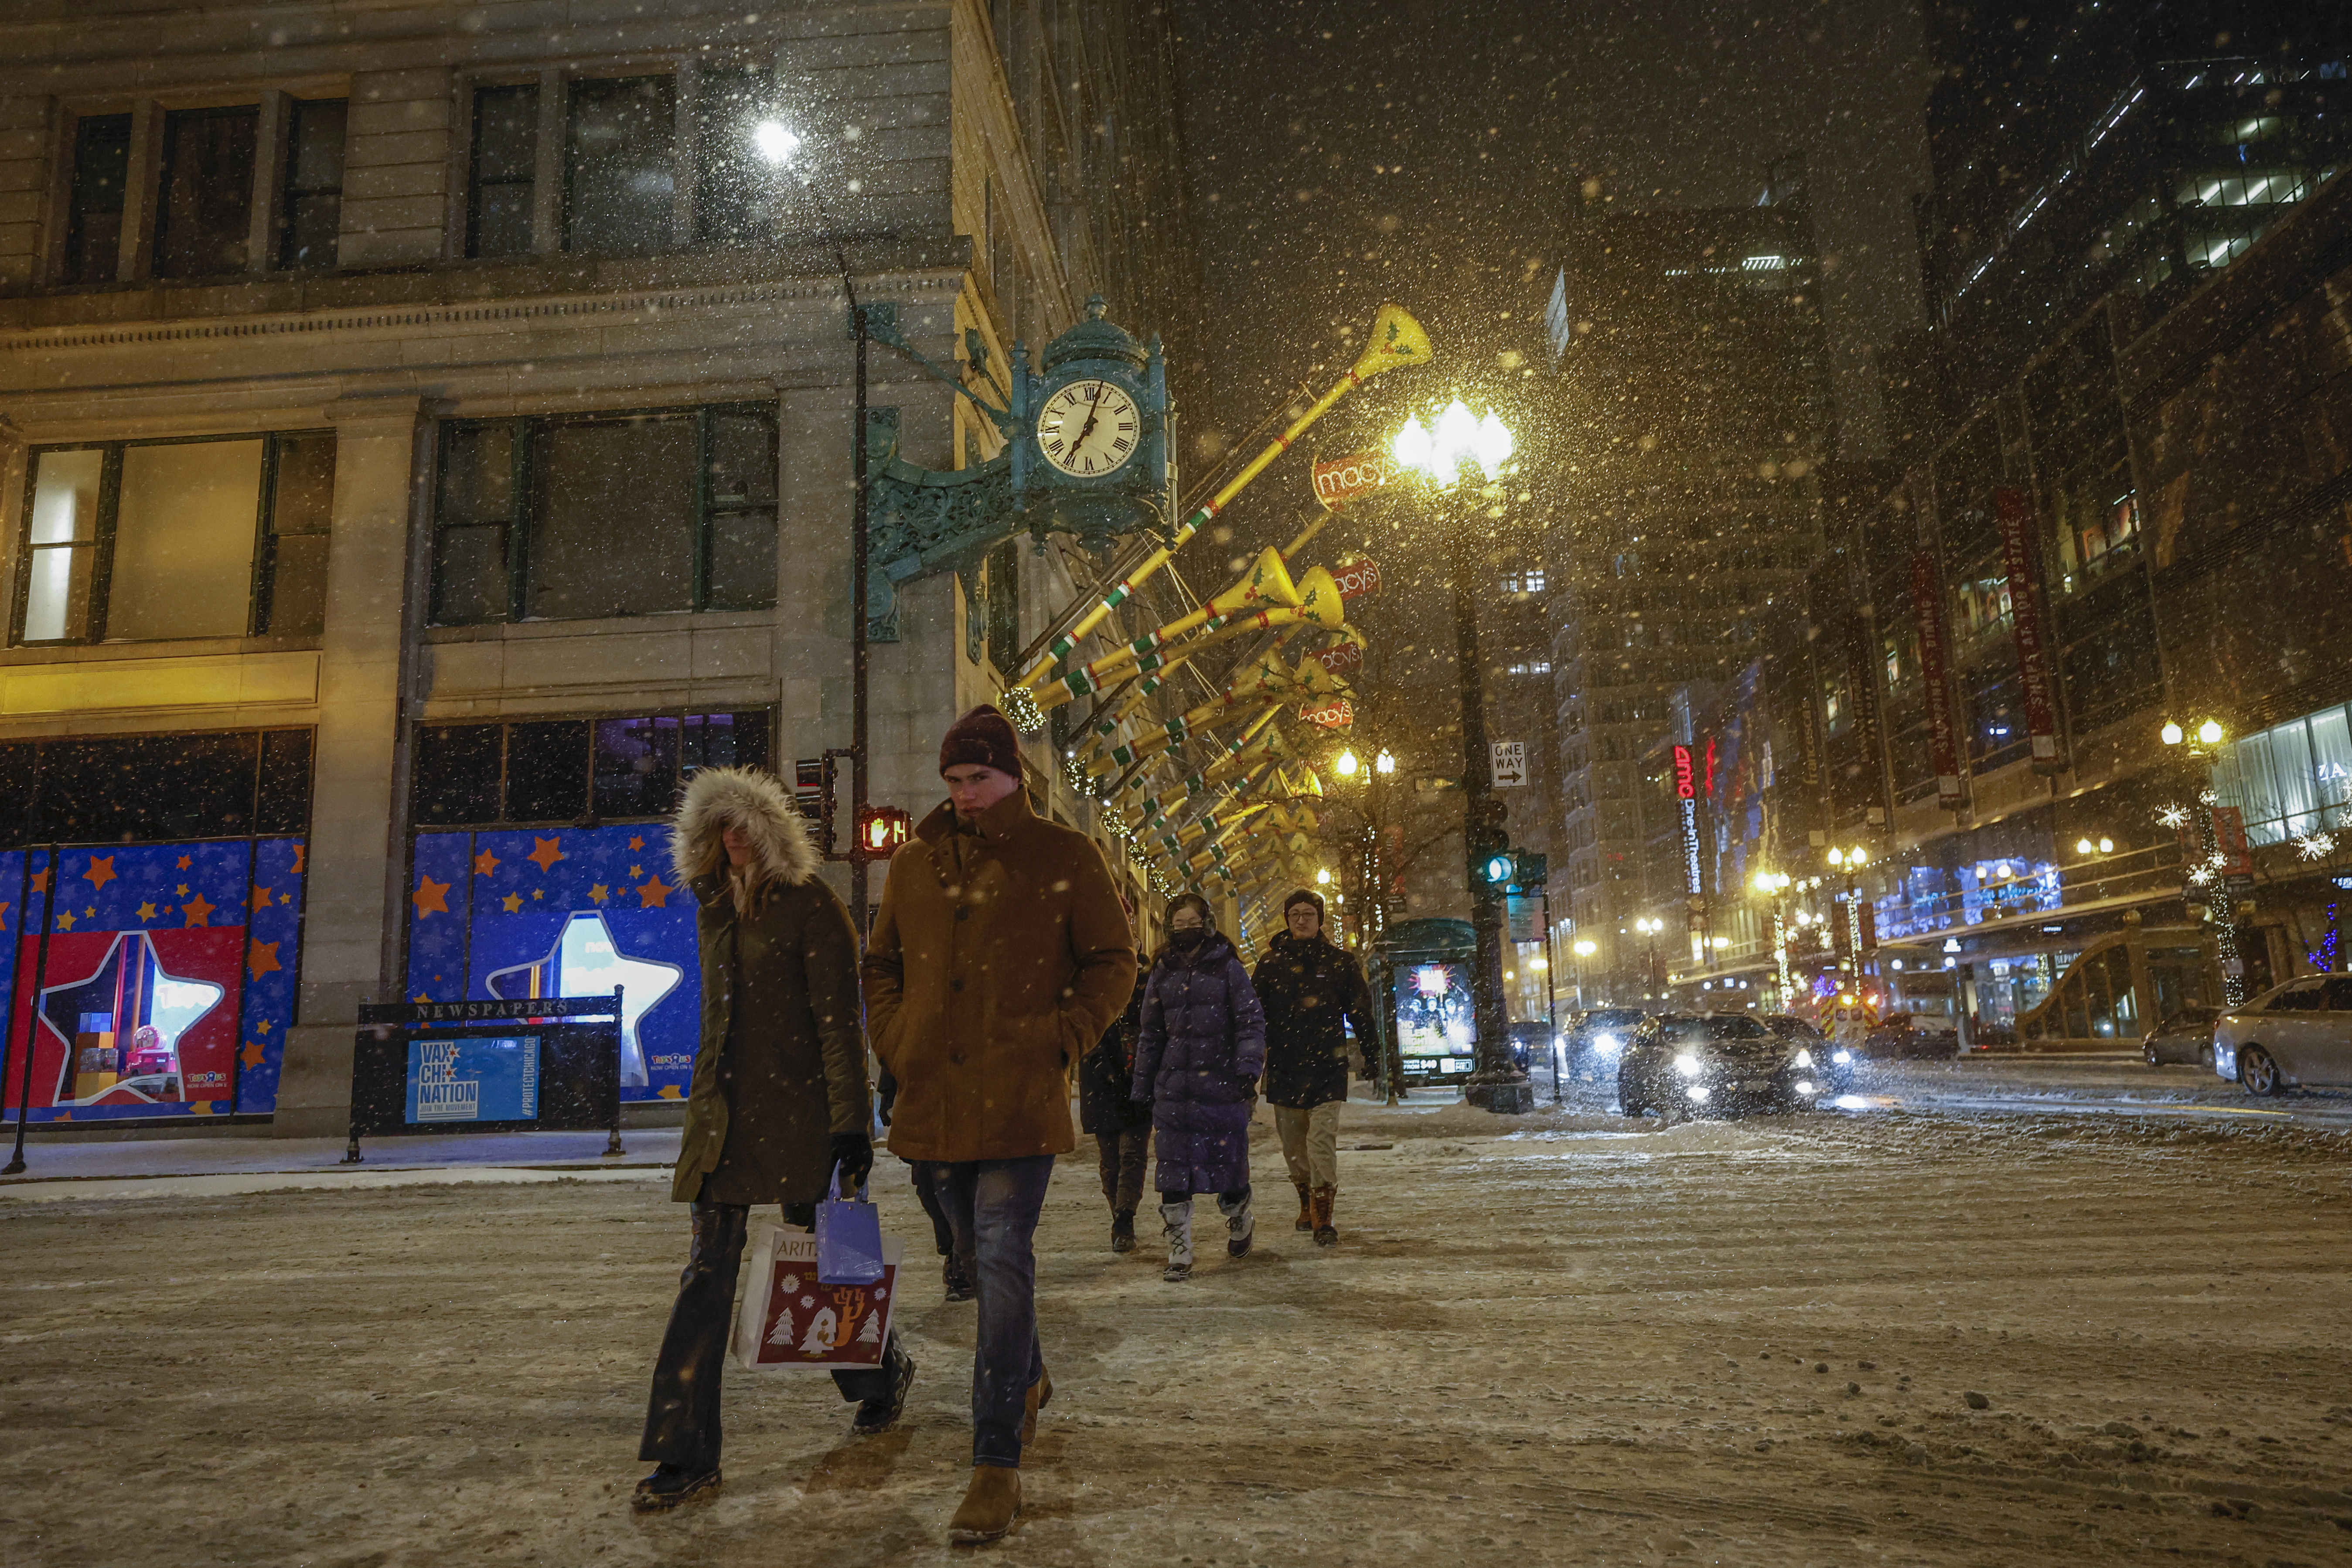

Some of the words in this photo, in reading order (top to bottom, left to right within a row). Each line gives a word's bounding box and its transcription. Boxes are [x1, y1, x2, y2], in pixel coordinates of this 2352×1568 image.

[1118, 422, 1133, 432] III
[1318, 458, 1386, 495] macy
[2008, 520, 2024, 565] STATE
[1334, 562, 1377, 593] acy's
[2021, 628, 2034, 646] AT
[1321, 644, 1360, 669] acy's
[2025, 654, 2043, 706] SHOPS
[1930, 679, 1949, 750] SHOPPING
[1496, 745, 1522, 757] ONE
[1798, 700, 1819, 784] francesca's
[1496, 757, 1523, 769] WAY
[1685, 798, 1698, 841] Dine-In
[1689, 838, 1701, 894] Theatres
[2056, 952, 2082, 964] SEPHO
[157, 985, 215, 1007] TS
[417, 999, 568, 1019] NEWSPAPERS
[1401, 1020, 1415, 1029] NO
[423, 1044, 451, 1064] VAX
[1420, 1060, 1437, 1069] $49
[522, 1038, 536, 1116] #PROTECTCHICAGO
[420, 1083, 476, 1104] NATION
[777, 1241, 818, 1256] ARIT
